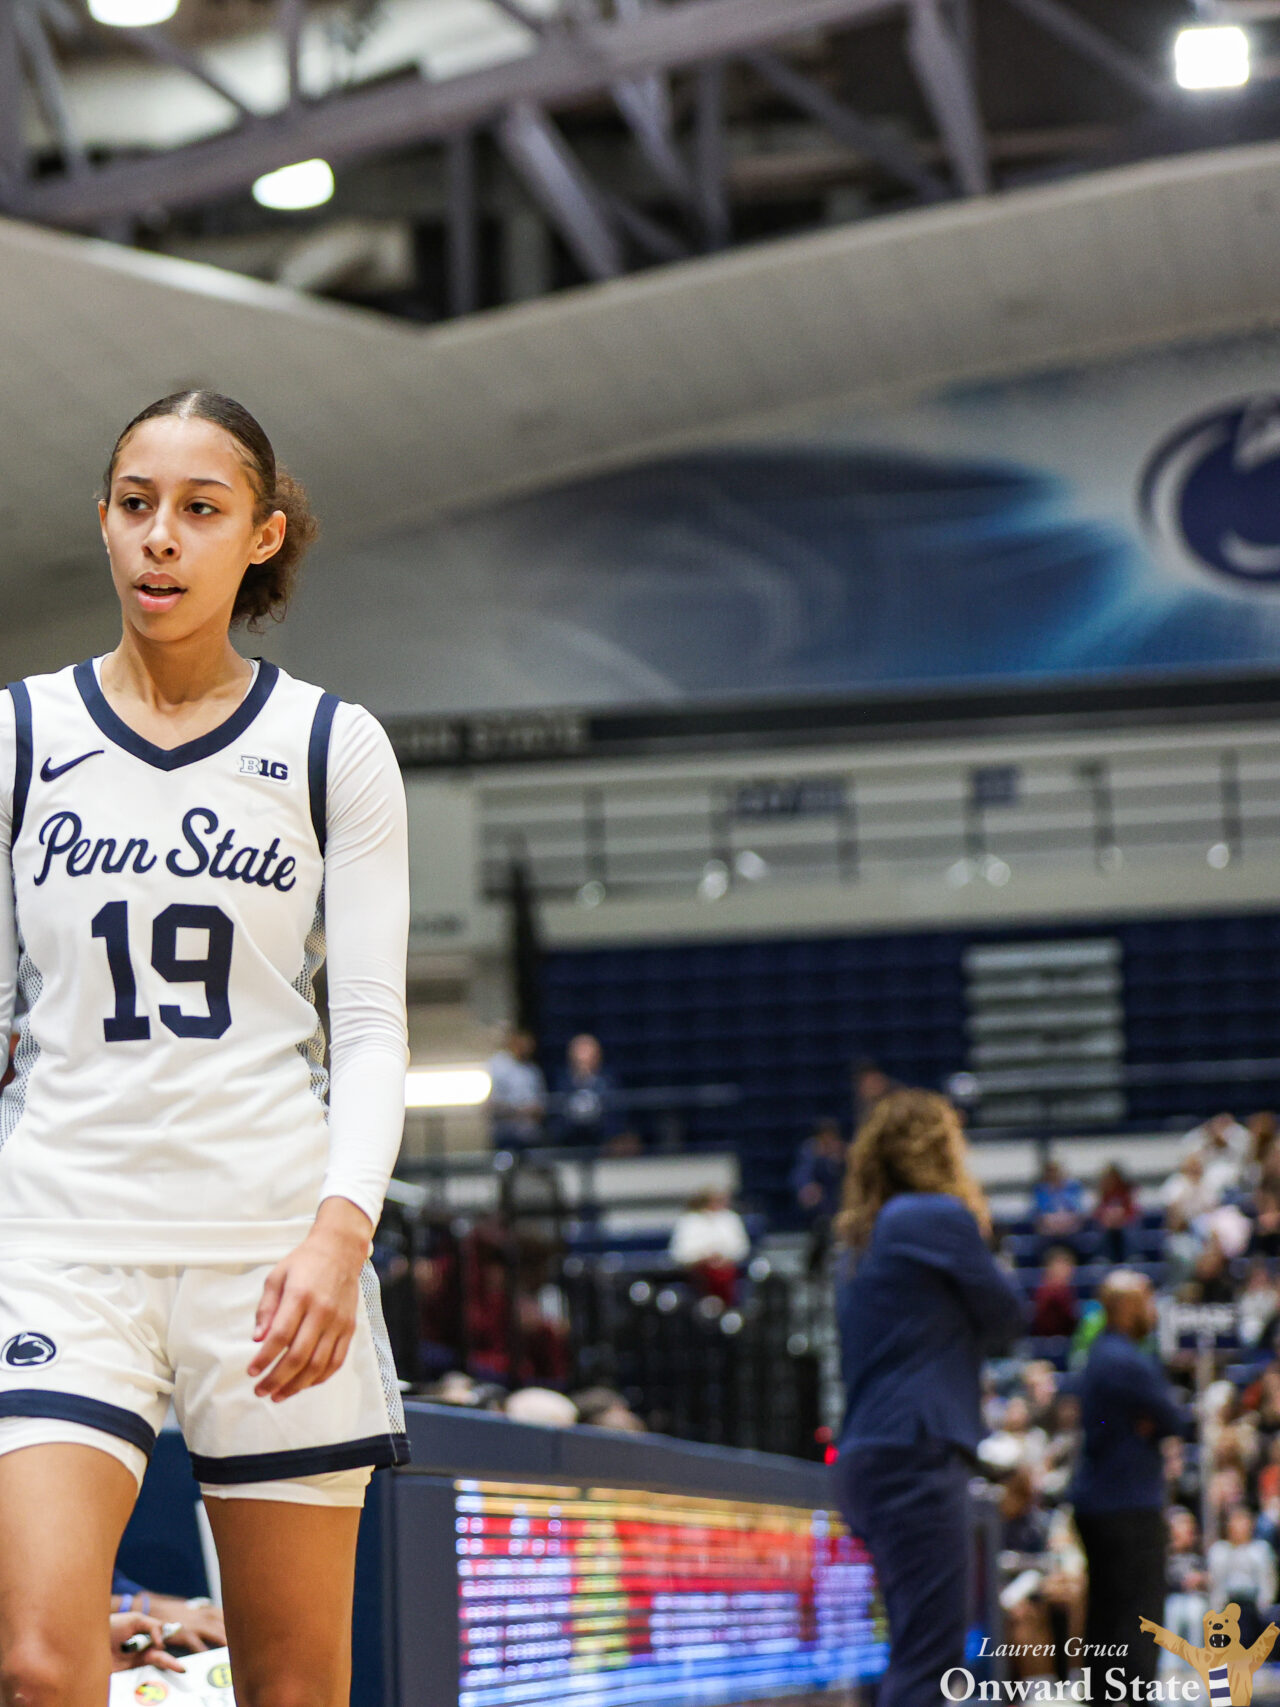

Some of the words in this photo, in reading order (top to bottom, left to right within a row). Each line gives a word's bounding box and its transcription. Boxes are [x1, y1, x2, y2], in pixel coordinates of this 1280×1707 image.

[34, 811, 157, 886] Penn
[166, 808, 296, 892] State
[91, 900, 234, 1042] 19
